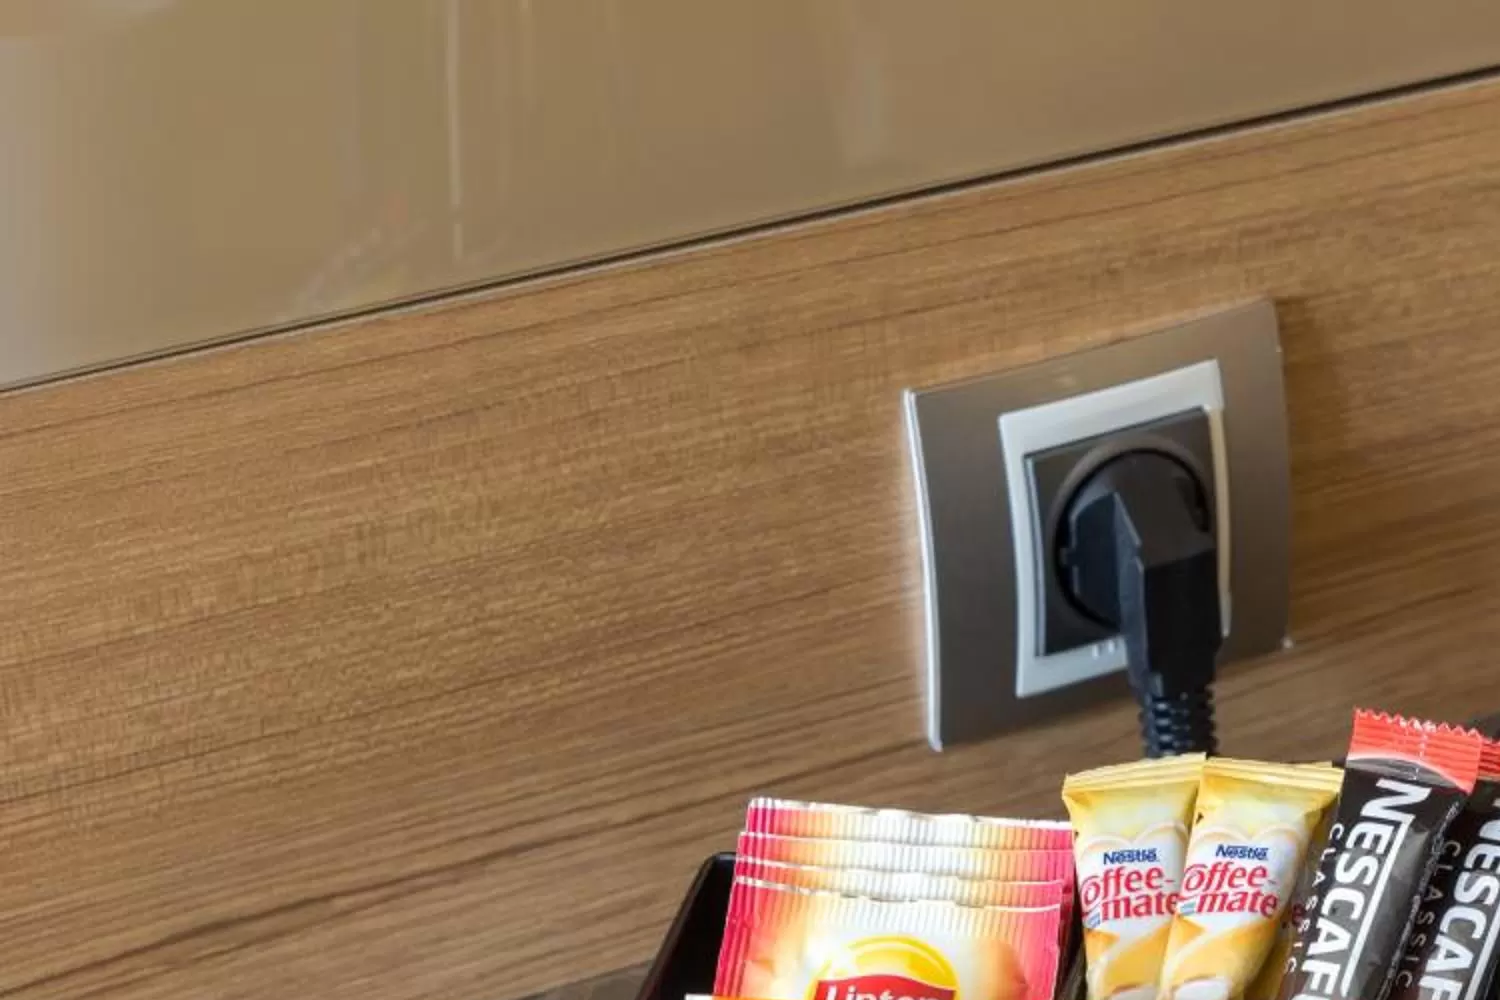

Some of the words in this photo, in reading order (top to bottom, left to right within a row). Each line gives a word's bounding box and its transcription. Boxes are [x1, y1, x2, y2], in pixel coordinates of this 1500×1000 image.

[1102, 891, 1179, 921] mate
[1195, 890, 1280, 918] mate
[1285, 822, 1344, 974] CLASSIC
[1395, 839, 1462, 989] CLASSIC
